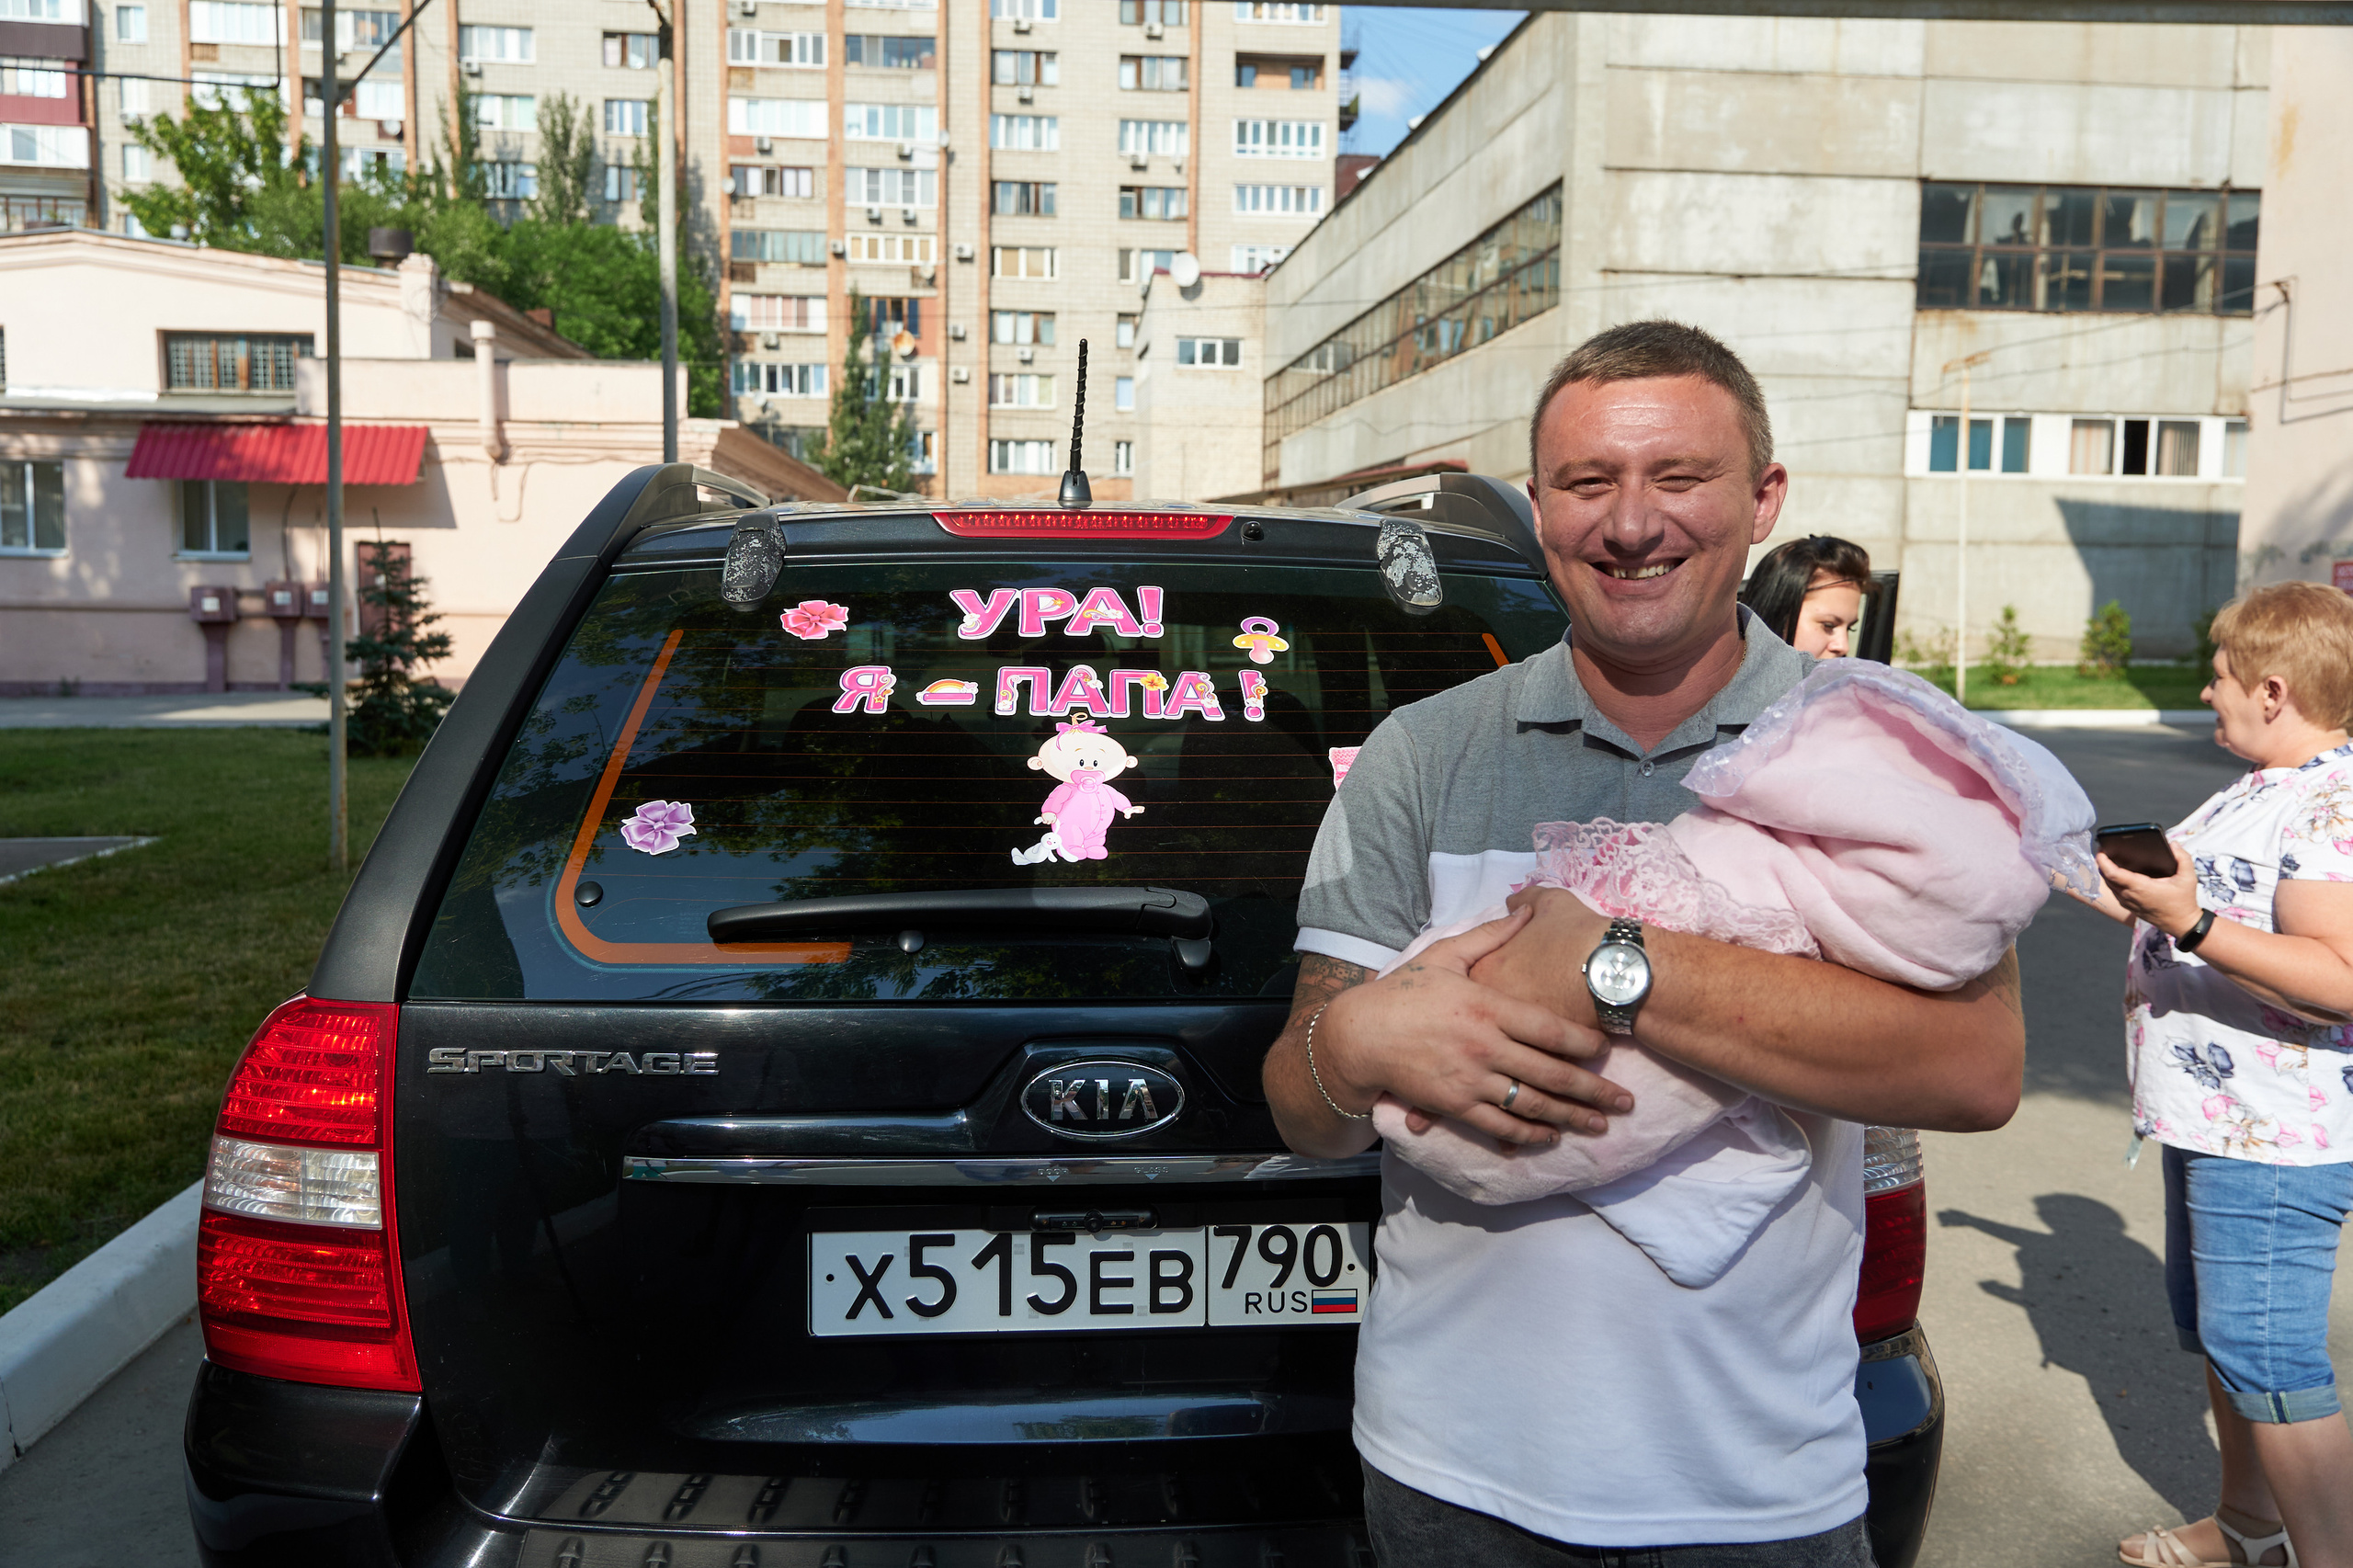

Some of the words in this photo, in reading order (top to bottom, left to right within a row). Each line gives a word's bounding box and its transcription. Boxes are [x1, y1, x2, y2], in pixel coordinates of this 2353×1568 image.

[949, 585, 1165, 639] УРА!
[832, 665, 897, 714] Я
[426, 1047, 721, 1076] SPORTAGE
[1048, 1078, 1159, 1120] KIA
[1212, 1224, 1345, 1290] 790
[1245, 1290, 1309, 1314] RUS
